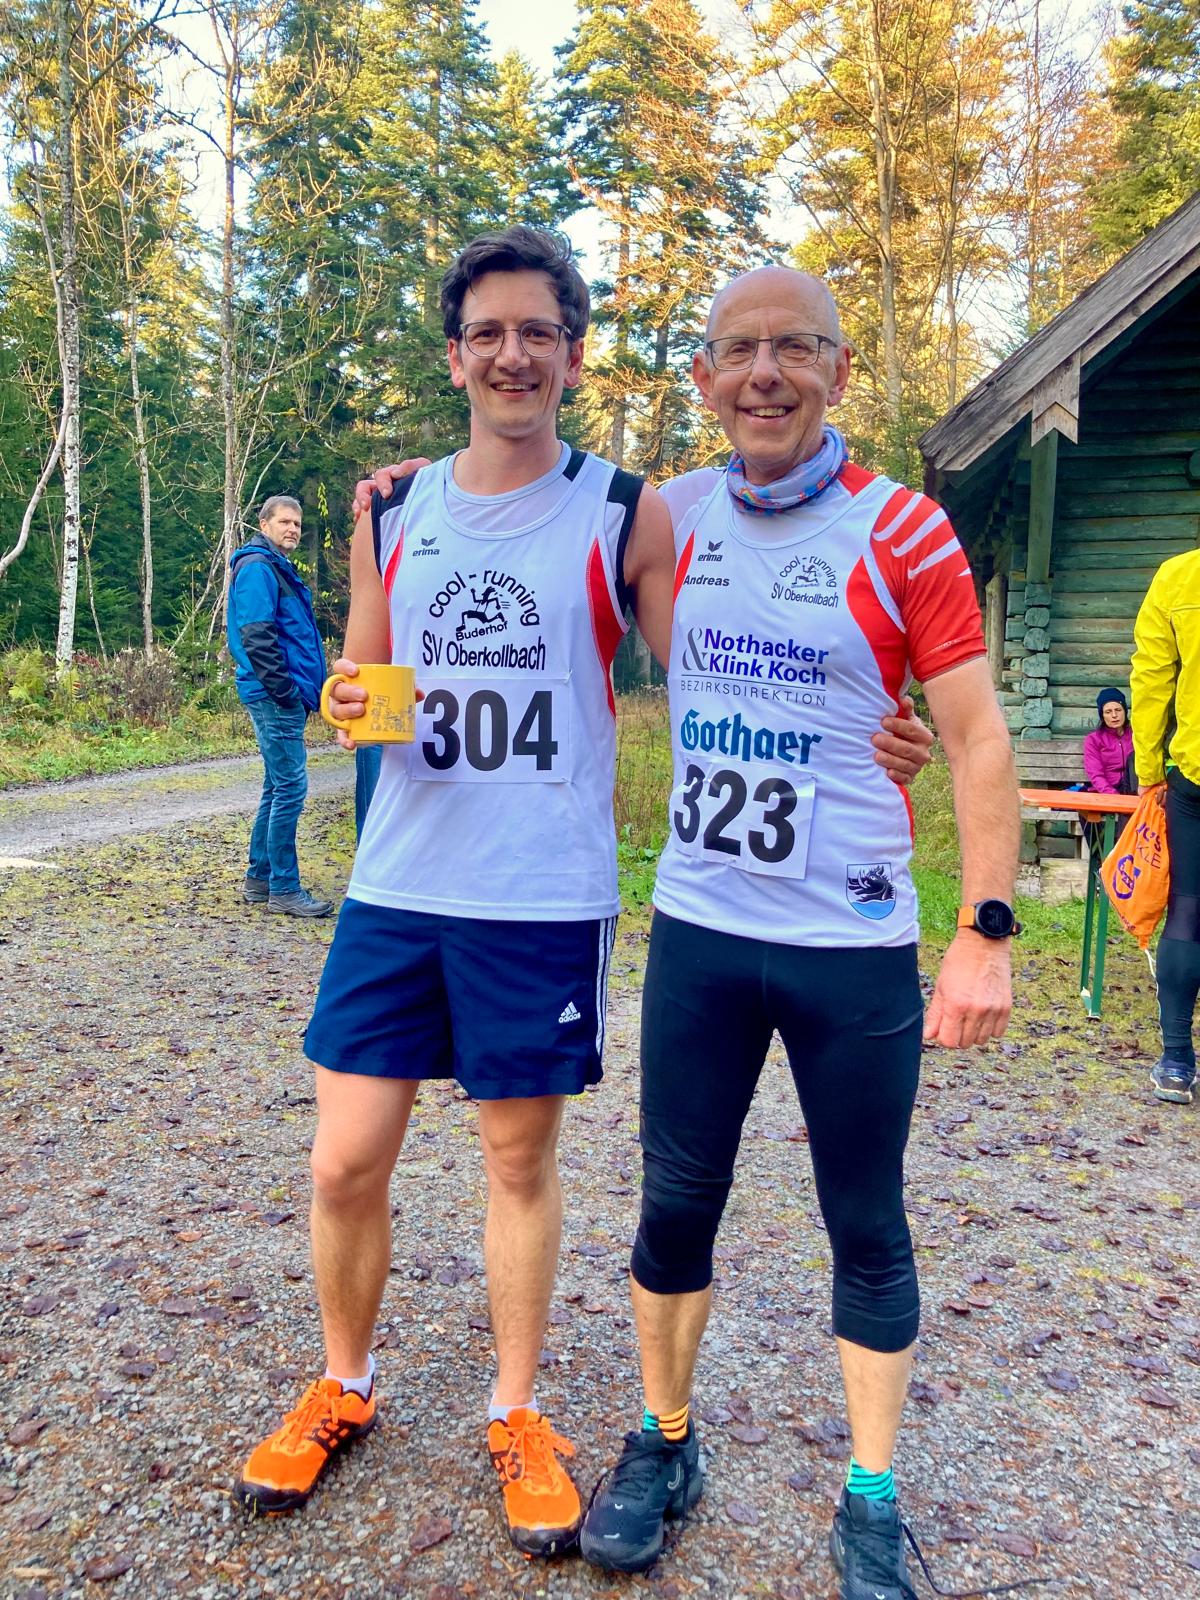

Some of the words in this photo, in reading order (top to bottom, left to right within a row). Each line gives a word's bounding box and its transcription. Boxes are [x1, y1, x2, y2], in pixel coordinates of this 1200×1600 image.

[412, 548, 440, 557] erima
[697, 553, 723, 562] erima
[683, 574, 730, 587] Andreas
[770, 582, 785, 600] SV
[784, 588, 839, 608] Oberkollbach
[456, 621, 508, 641] Buderhof
[422, 629, 443, 666] SV
[446, 635, 546, 671] Oberkollbach
[704, 628, 829, 665] Nothacker
[709, 653, 764, 678] Klink
[768, 660, 826, 685] Koch
[680, 680, 826, 707] BEZIRKSDIREKTION
[422, 688, 559, 772] 304
[680, 708, 823, 765] Gothaer
[673, 763, 798, 864] 323
